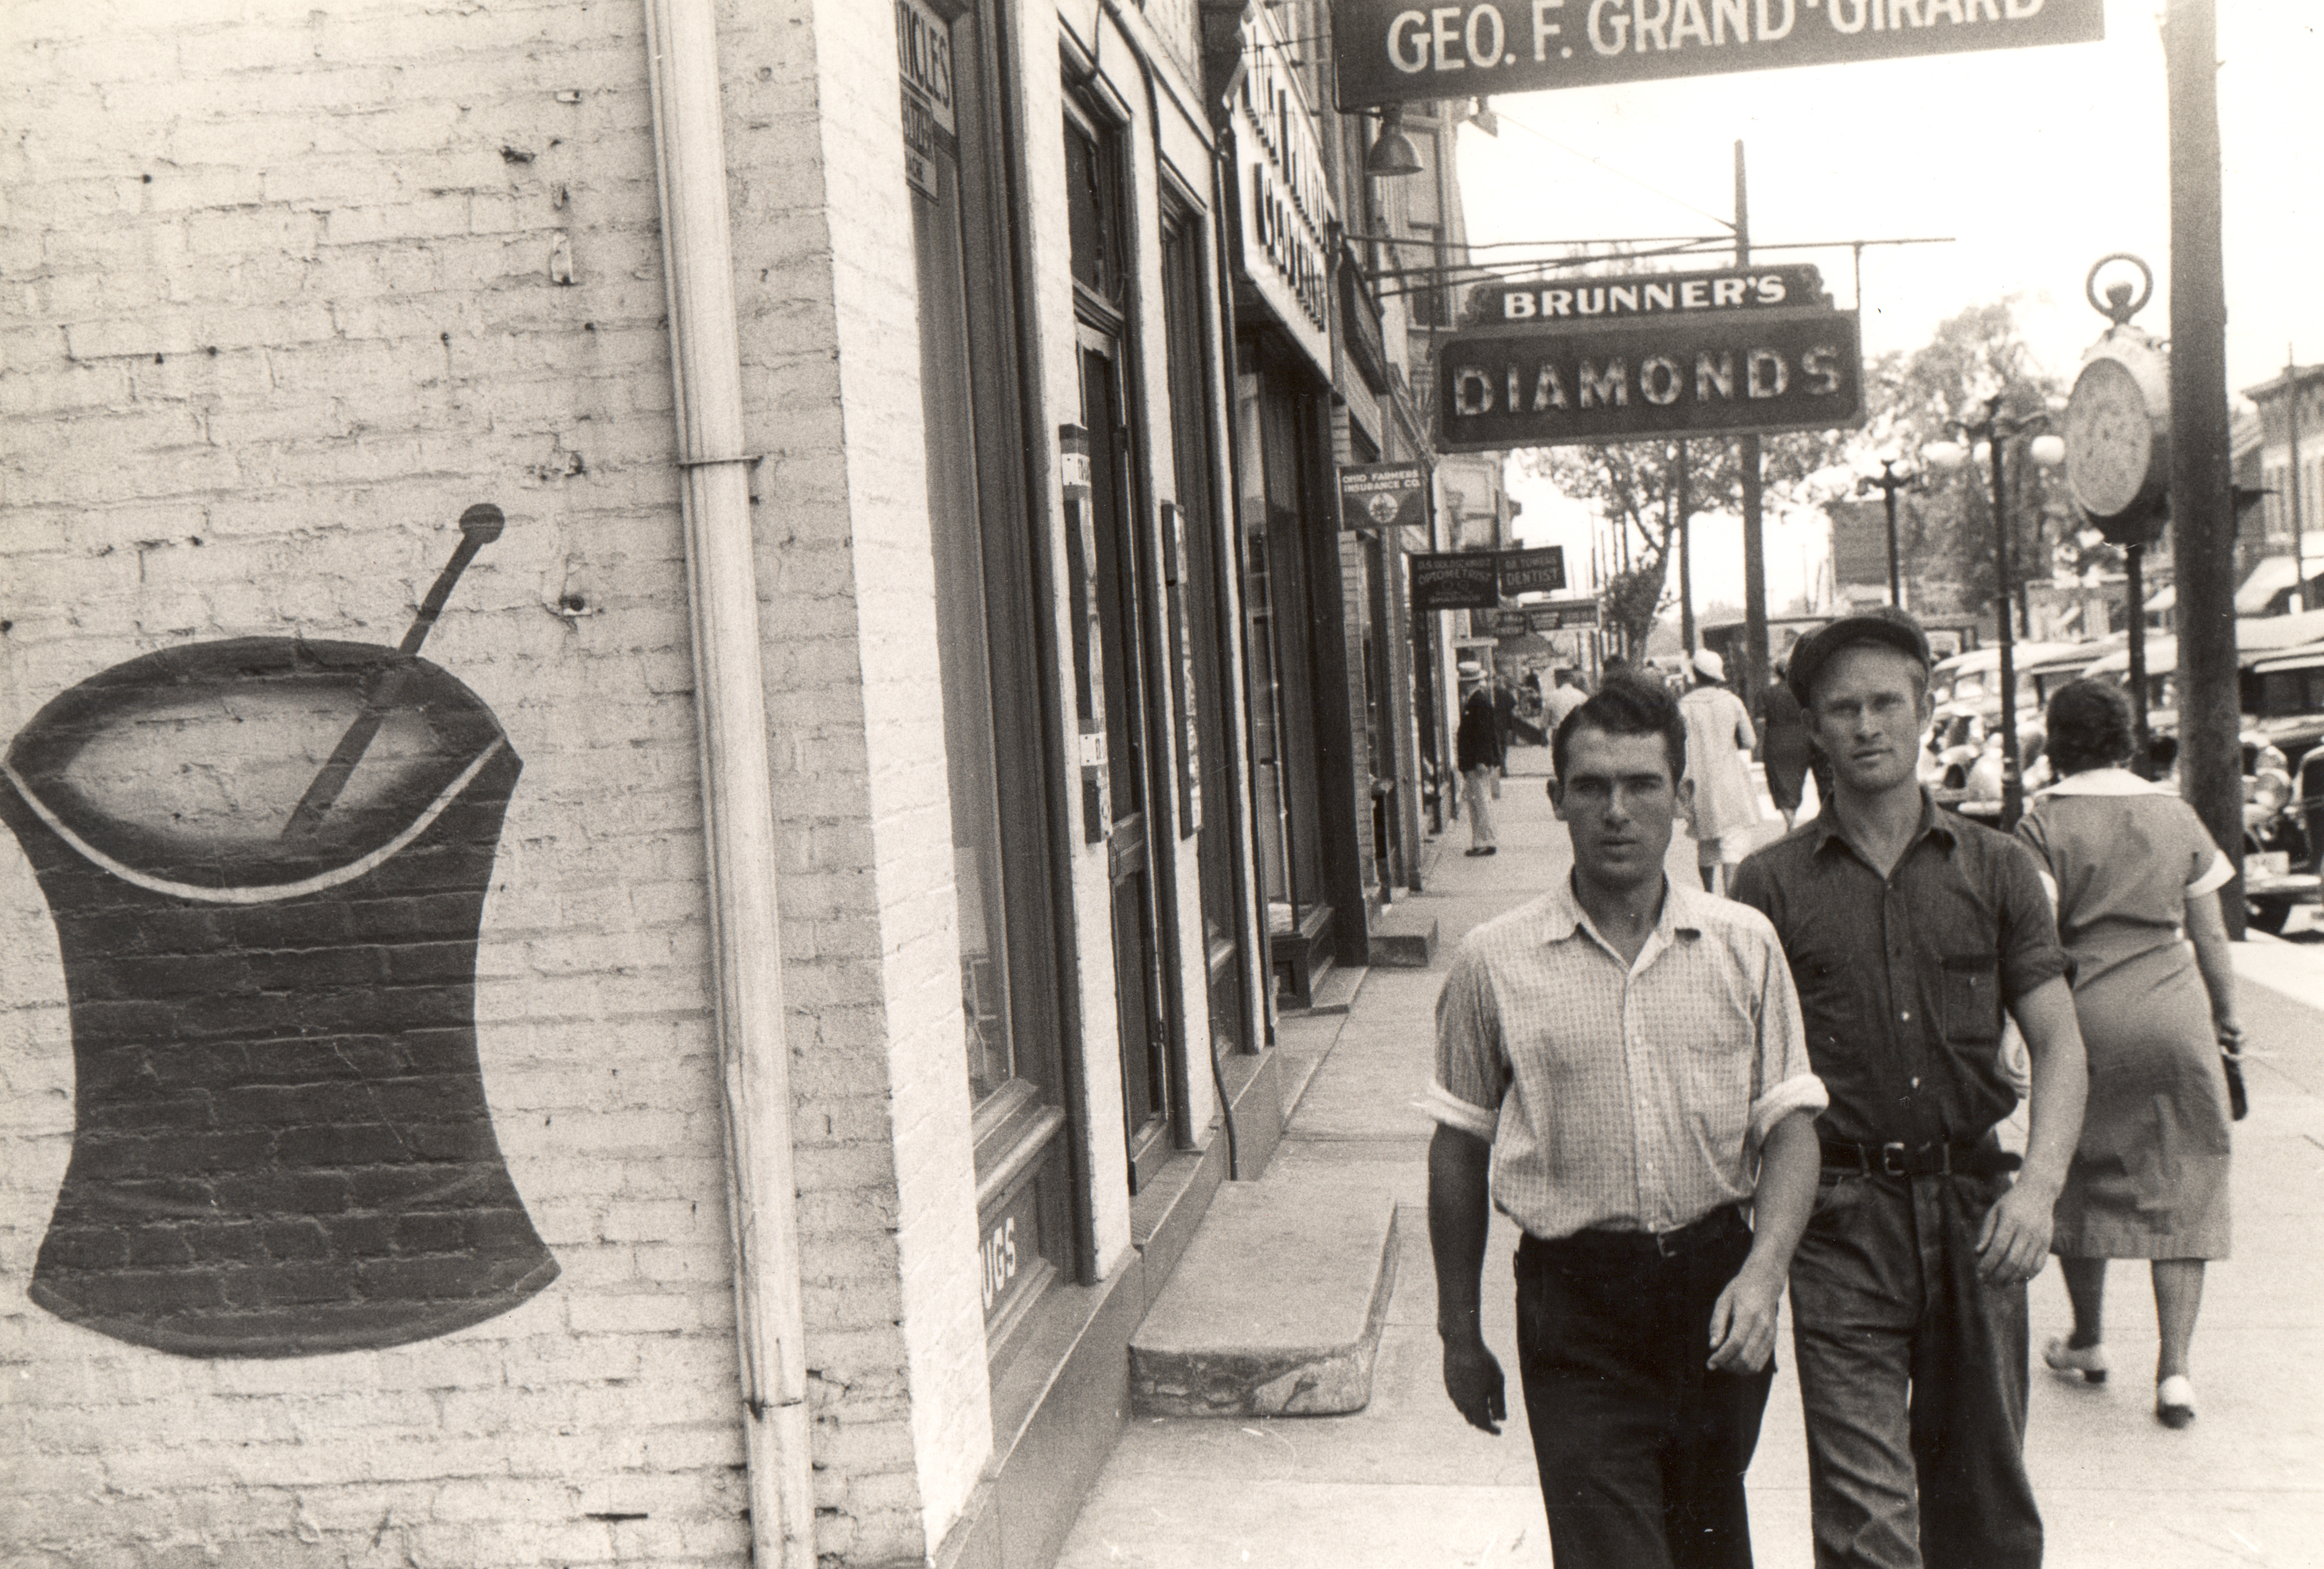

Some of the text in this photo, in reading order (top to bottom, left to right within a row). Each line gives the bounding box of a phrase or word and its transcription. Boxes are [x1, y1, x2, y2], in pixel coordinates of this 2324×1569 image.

[1388, 3, 1516, 74] GEO.
[1531, 0, 1572, 61] F.
[1504, 275, 1787, 320] BRUNNER'S
[1453, 345, 1839, 418] DIAMONDS
[1343, 469, 1419, 484] OHIO FARMERS
[1343, 481, 1401, 493] INSURANCE
[1418, 567, 1493, 585] OPTOMETRIST
[1506, 567, 1558, 586] DENTIST
